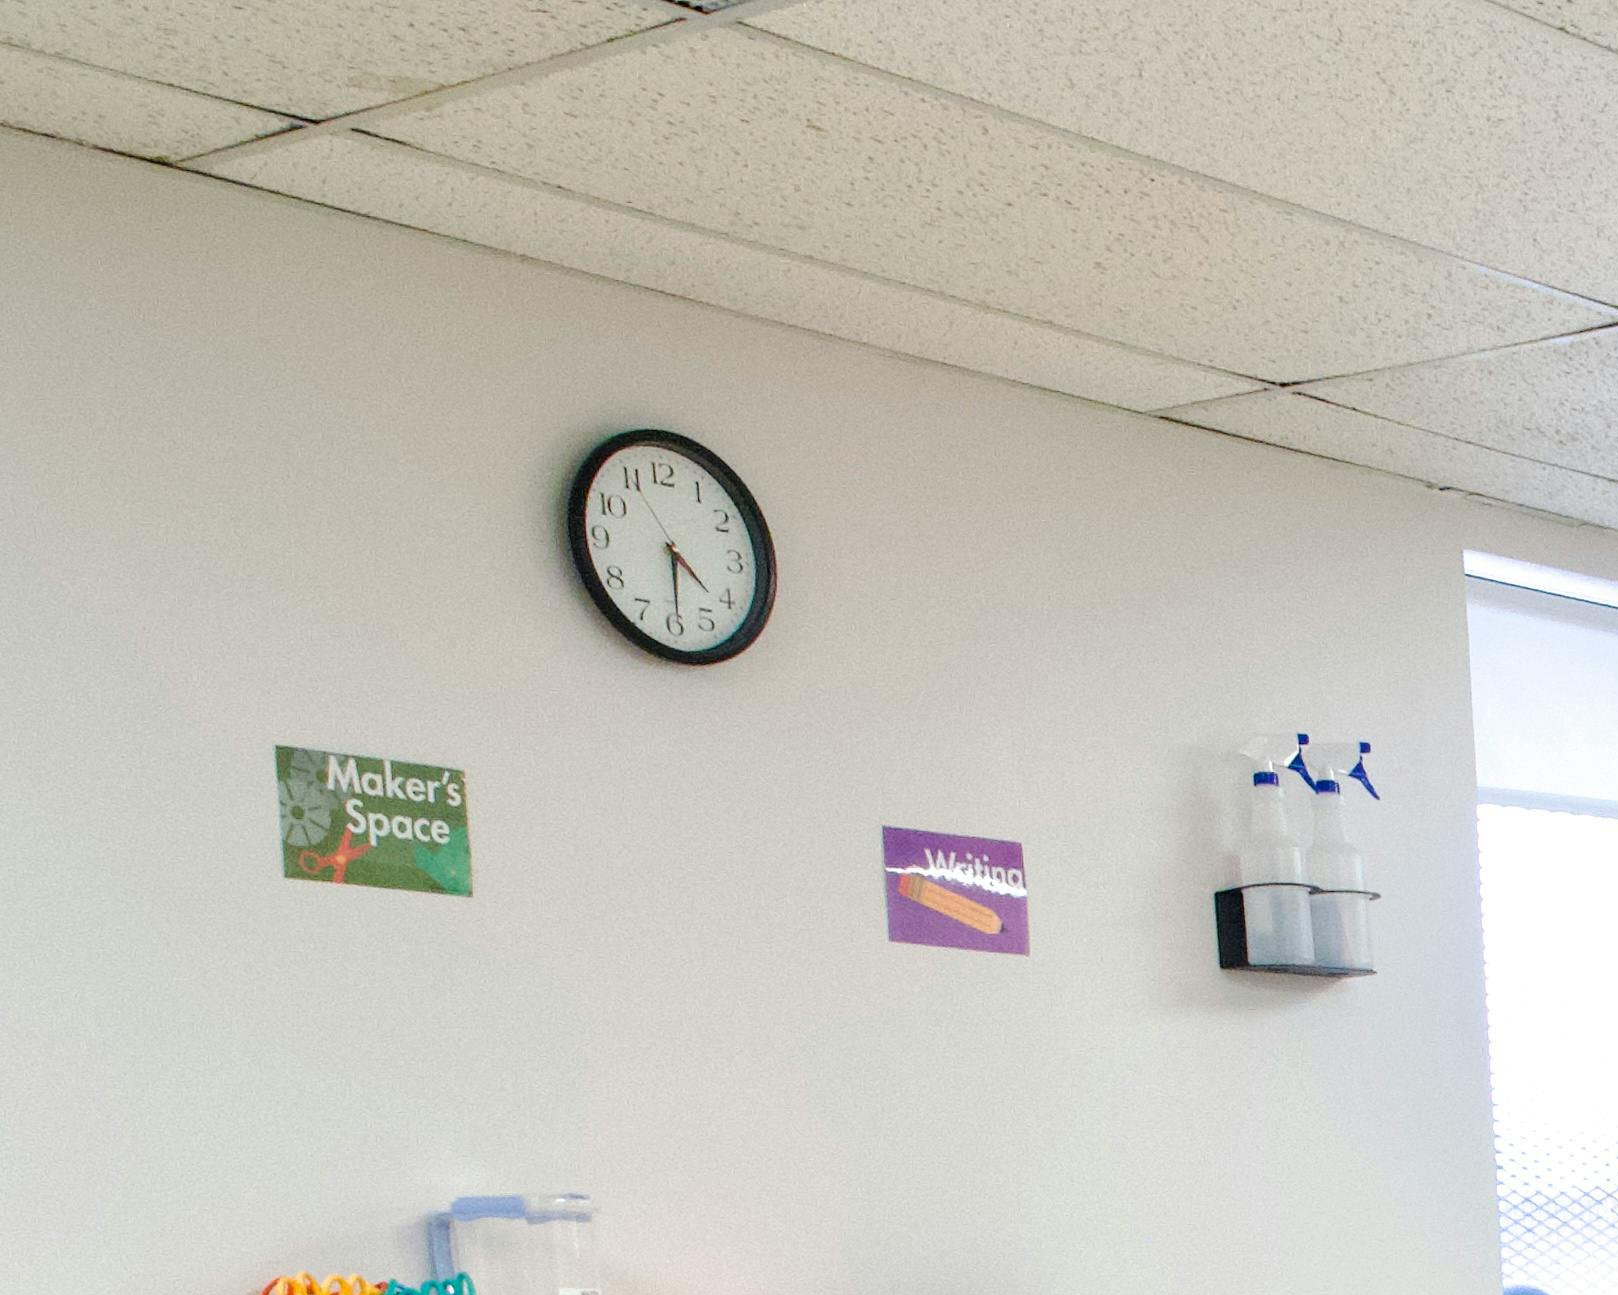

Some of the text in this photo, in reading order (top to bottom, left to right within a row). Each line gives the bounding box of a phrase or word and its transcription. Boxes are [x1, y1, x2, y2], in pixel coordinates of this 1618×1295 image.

[624, 466, 640, 491] 11
[652, 461, 675, 487] 12
[694, 480, 701, 504] 1
[601, 492, 627, 519] 10
[713, 508, 729, 533] 2
[592, 524, 610, 549] 9
[727, 550, 743, 574] 3
[606, 565, 624, 590] 8
[635, 597, 650, 620] 7
[719, 587, 735, 609] 4
[666, 612, 684, 636] 6
[698, 607, 715, 632] 5
[326, 755, 462, 807] Maker's
[345, 798, 450, 846] Space
